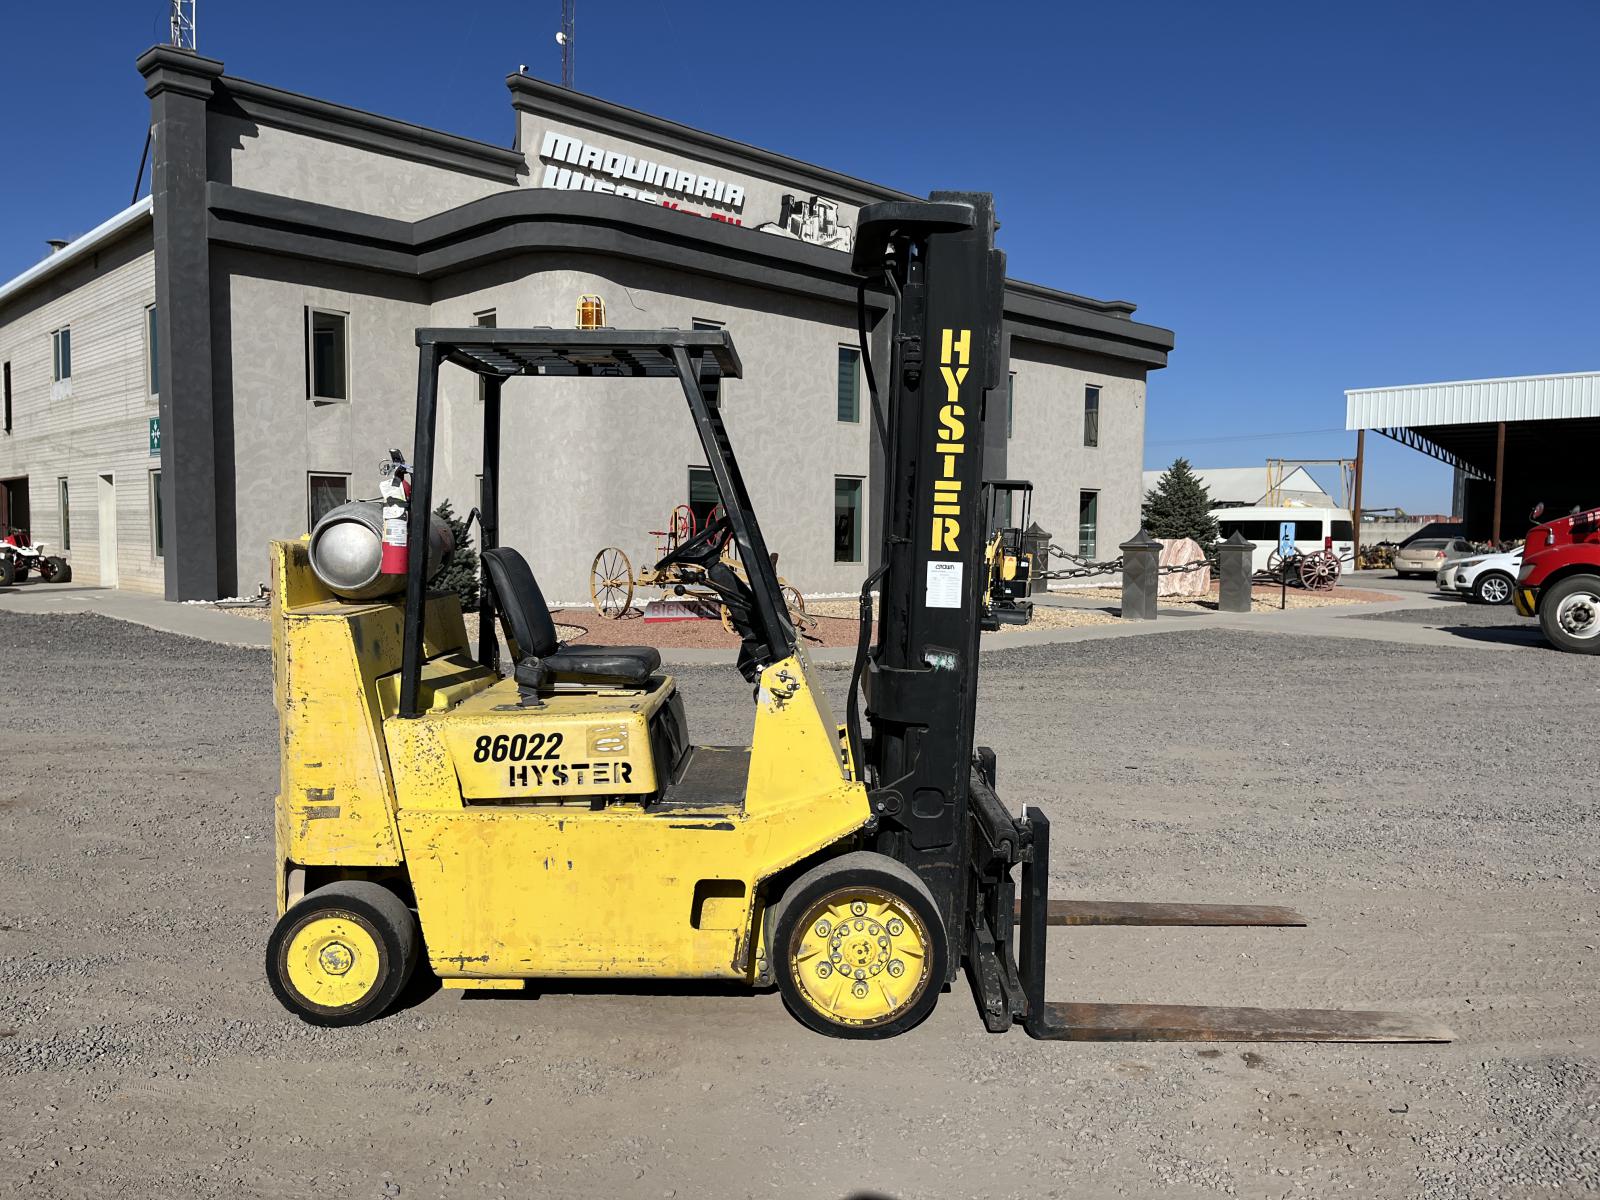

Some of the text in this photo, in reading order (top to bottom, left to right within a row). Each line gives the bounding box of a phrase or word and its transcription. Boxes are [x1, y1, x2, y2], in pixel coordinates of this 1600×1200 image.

[540, 130, 744, 206] MAQUINARIA
[931, 329, 971, 552] HYSTER
[473, 732, 563, 763] 86022
[509, 762, 632, 787] HYSTER
